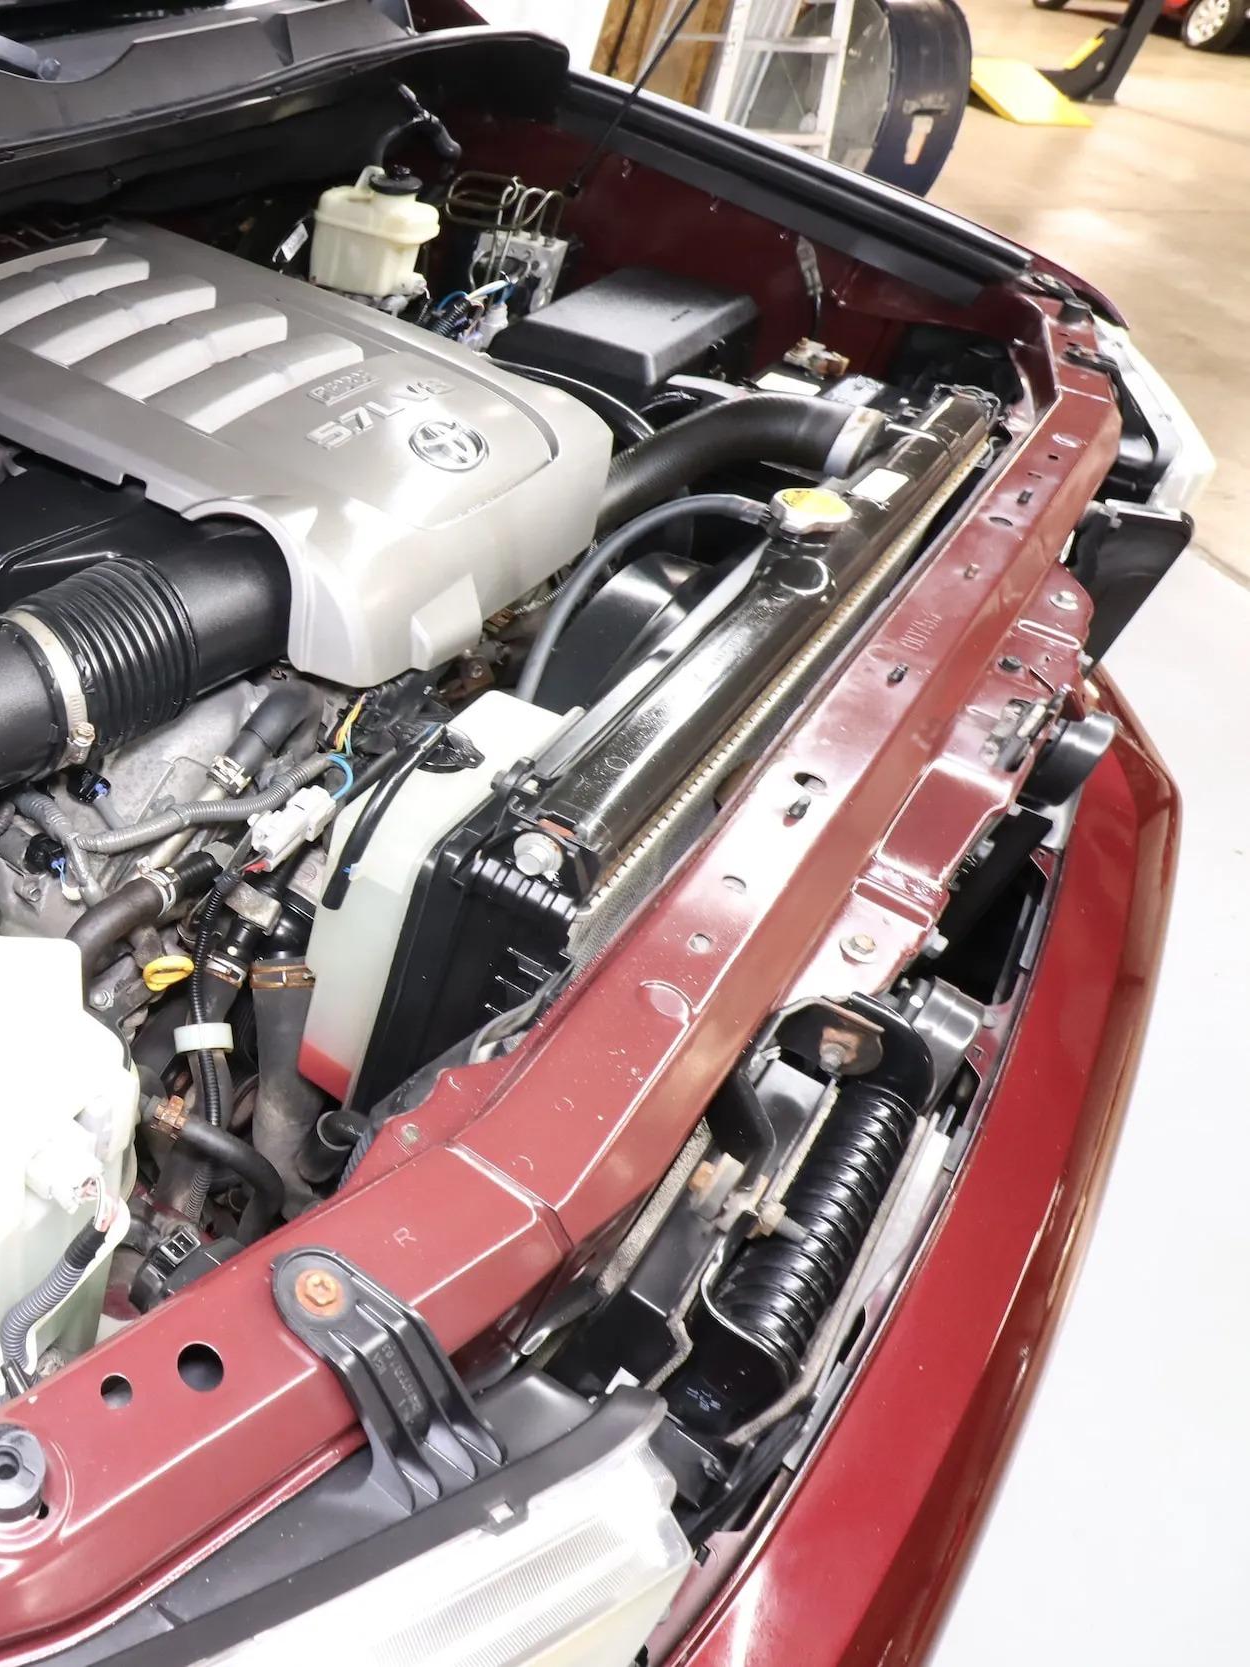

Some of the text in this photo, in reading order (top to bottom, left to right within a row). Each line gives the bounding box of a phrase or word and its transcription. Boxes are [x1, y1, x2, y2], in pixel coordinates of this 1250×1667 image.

[305, 401, 406, 449] 5.7L
[390, 377, 455, 402] V8
[392, 1227, 417, 1248] R
